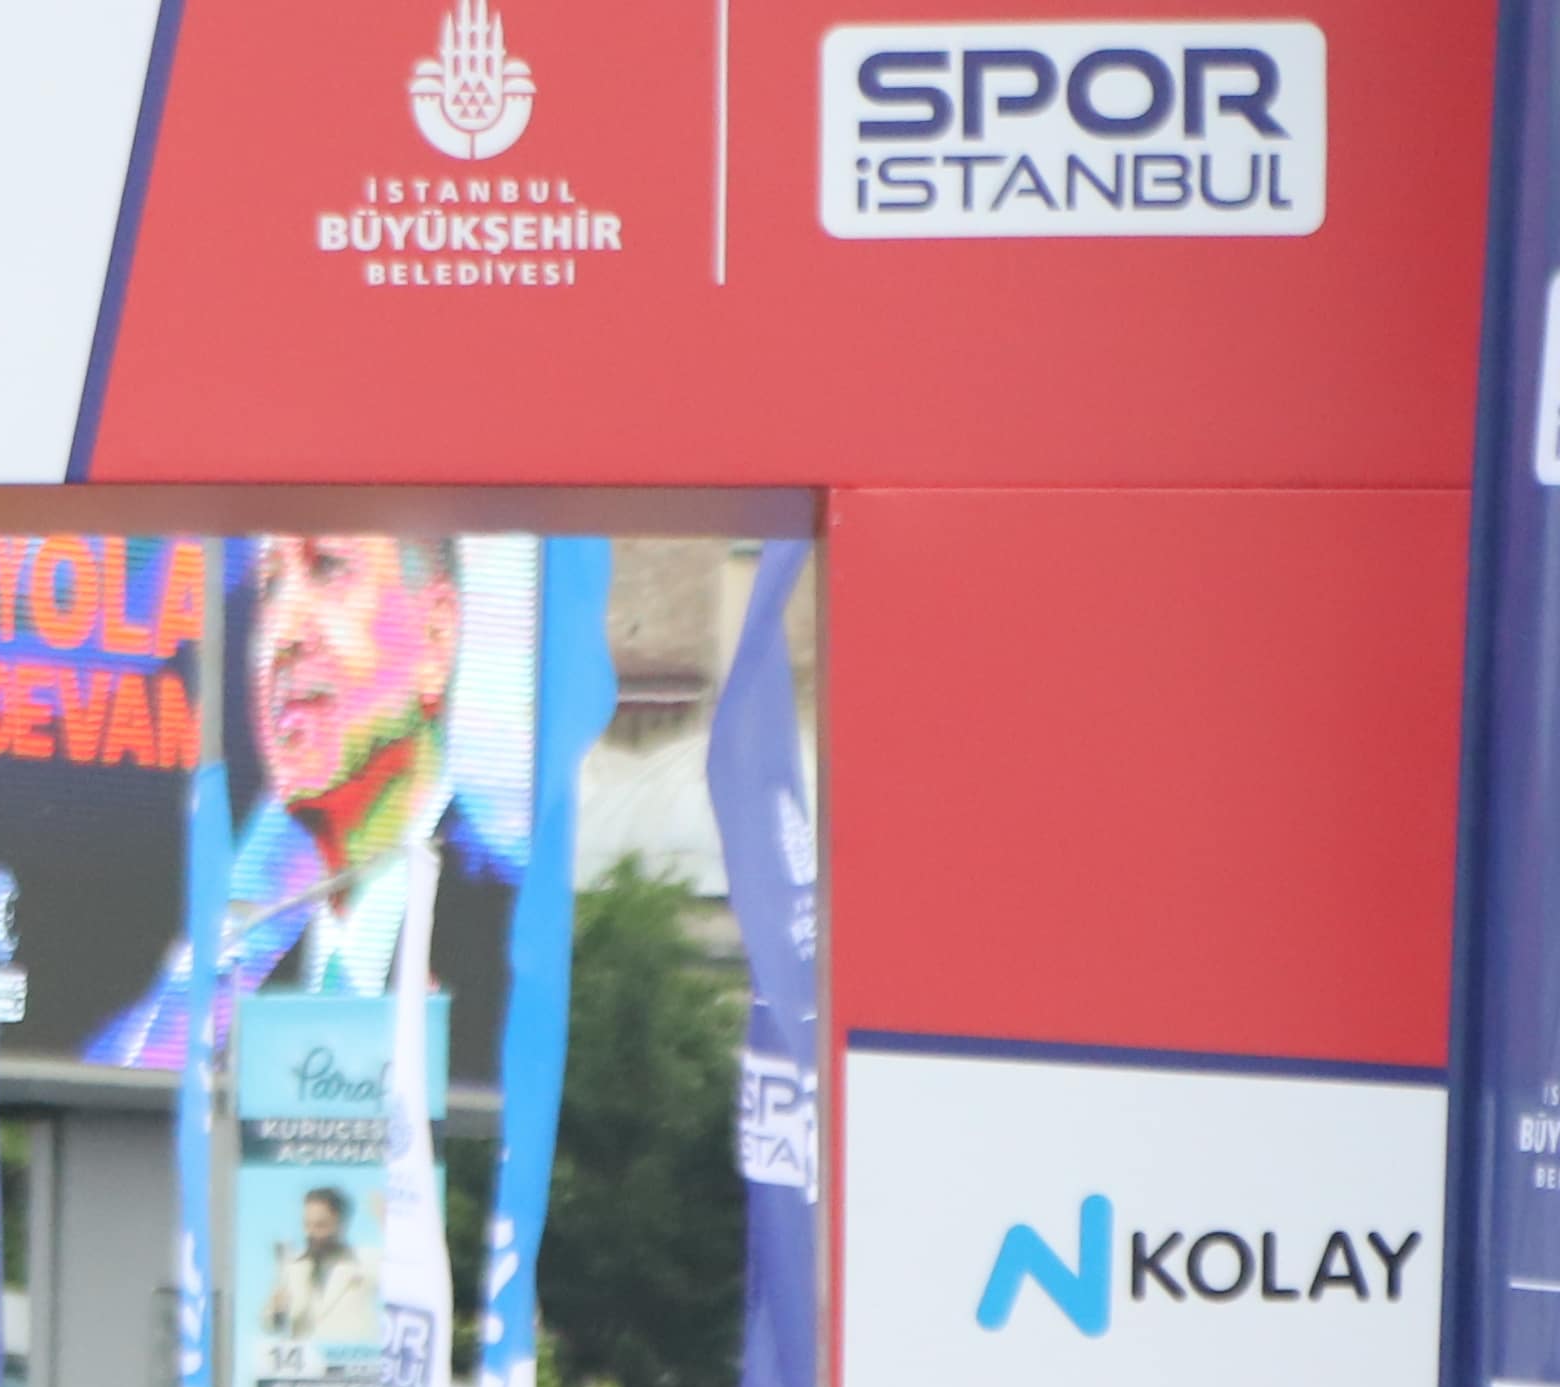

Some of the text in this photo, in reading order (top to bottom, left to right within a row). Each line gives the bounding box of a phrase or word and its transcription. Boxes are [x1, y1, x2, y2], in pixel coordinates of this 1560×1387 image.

[856, 47, 1290, 141] SPOR
[365, 173, 576, 205] İSTANBUL
[318, 206, 623, 257] BÜYÜKŞEHİR
[366, 259, 578, 286] BELEDİYESİ
[1129, 1229, 1422, 1302] KOLAY
